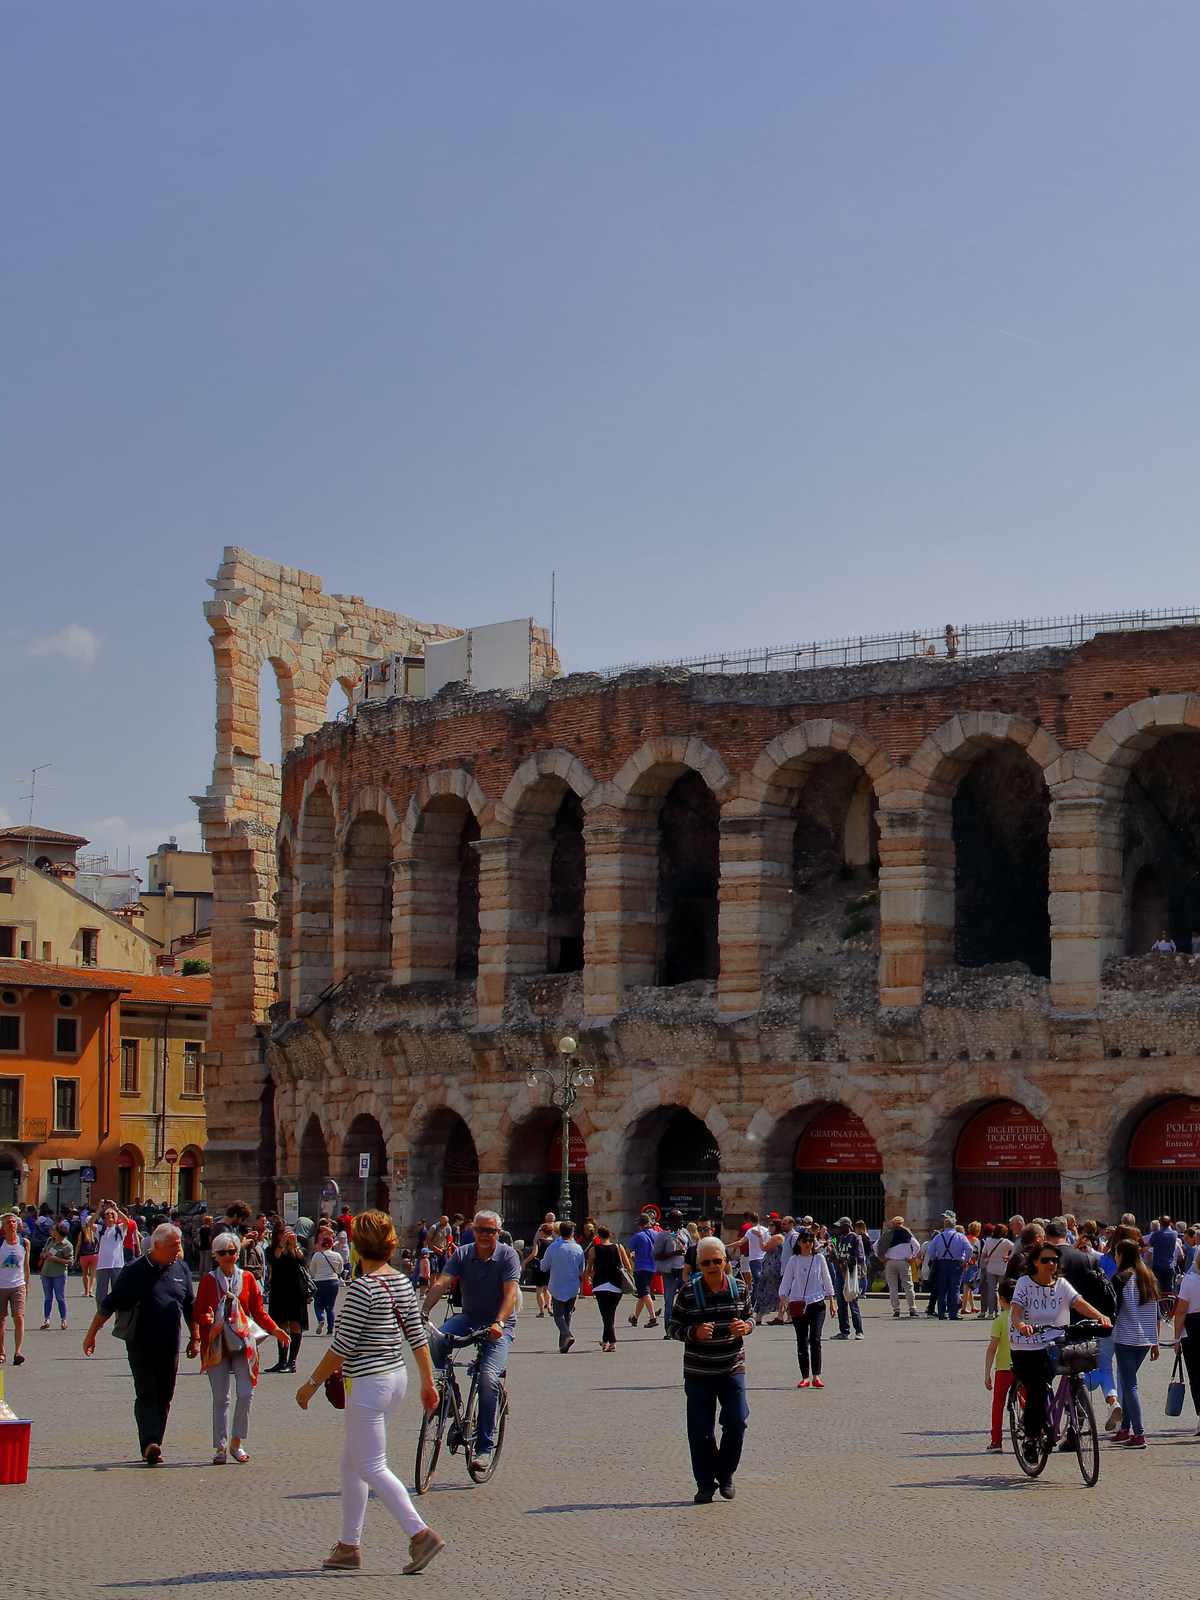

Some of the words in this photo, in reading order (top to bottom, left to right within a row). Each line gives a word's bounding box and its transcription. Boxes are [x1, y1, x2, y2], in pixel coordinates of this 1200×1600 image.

[810, 1130, 859, 1138] GRADINATA
[988, 1126, 1046, 1134] BIGLIETTERIA
[986, 1133, 1016, 1142] TICKET
[1017, 1133, 1048, 1142] OFFICE
[989, 1142, 1017, 1150] Cancello
